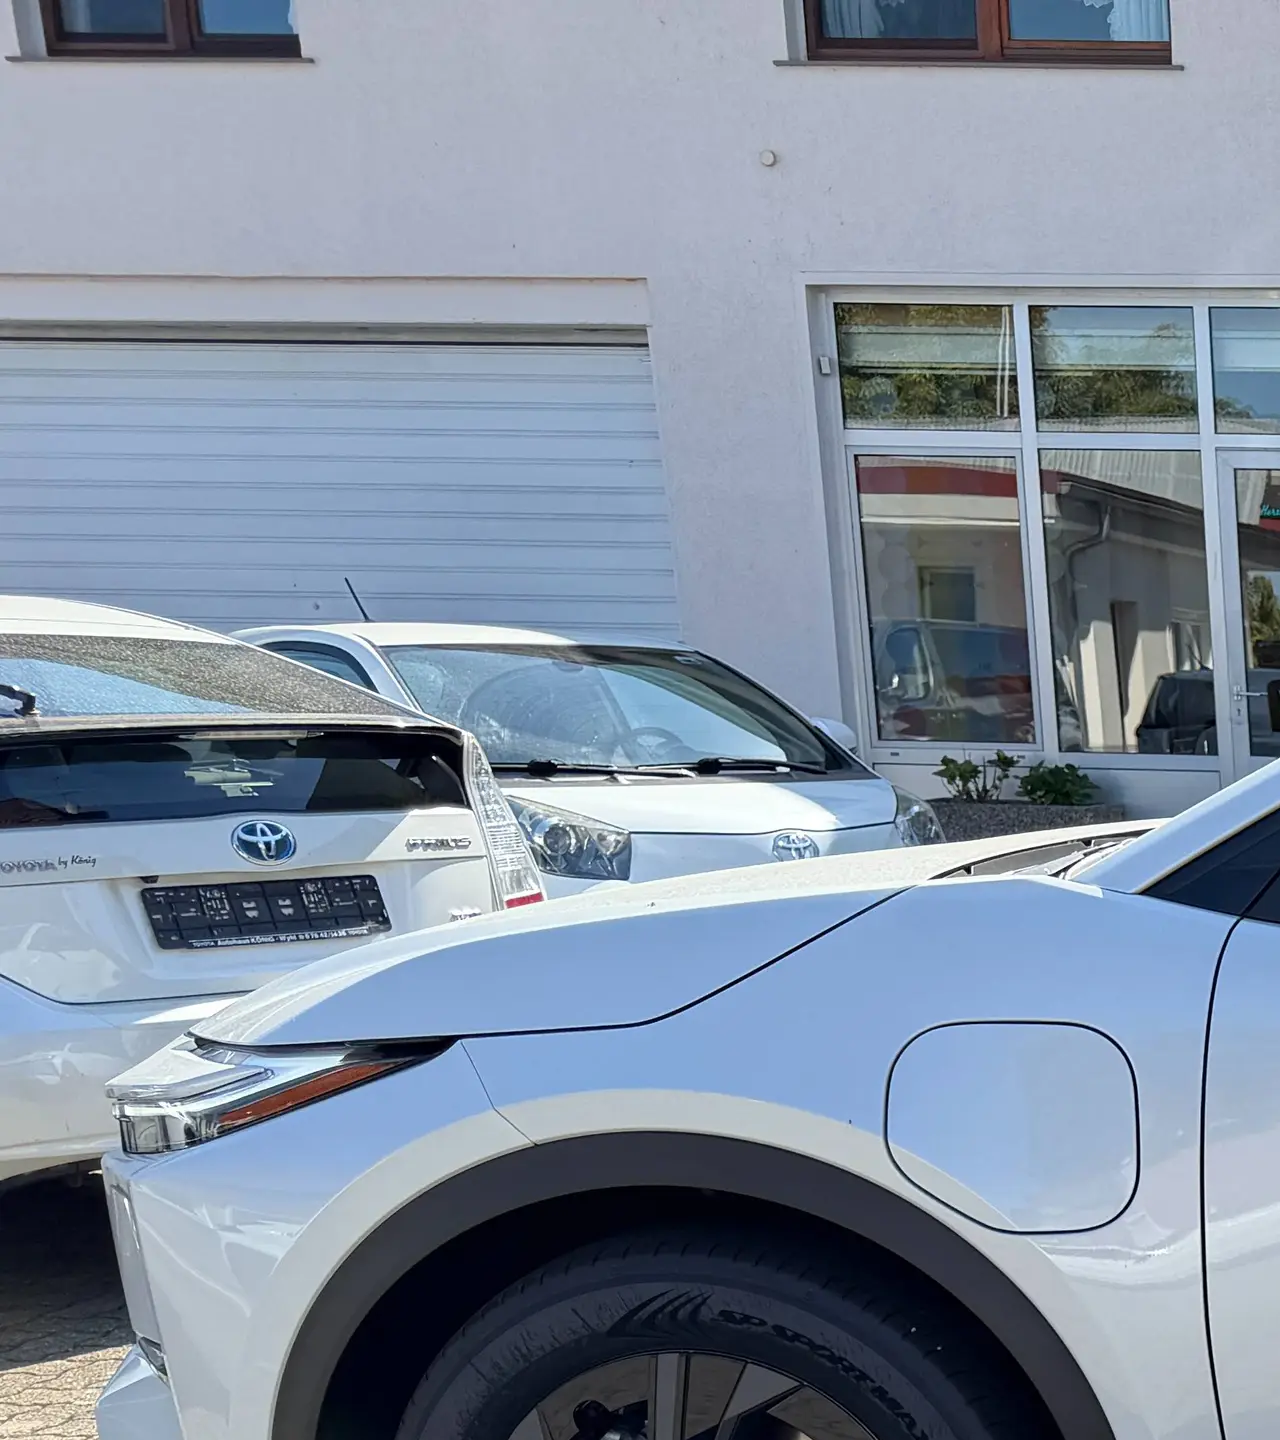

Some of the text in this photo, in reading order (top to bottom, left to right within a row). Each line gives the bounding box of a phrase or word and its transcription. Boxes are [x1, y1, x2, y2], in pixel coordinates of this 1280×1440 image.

[405, 837, 472, 852] PRIUS
[0, 855, 97, 873] OYOTA by König
